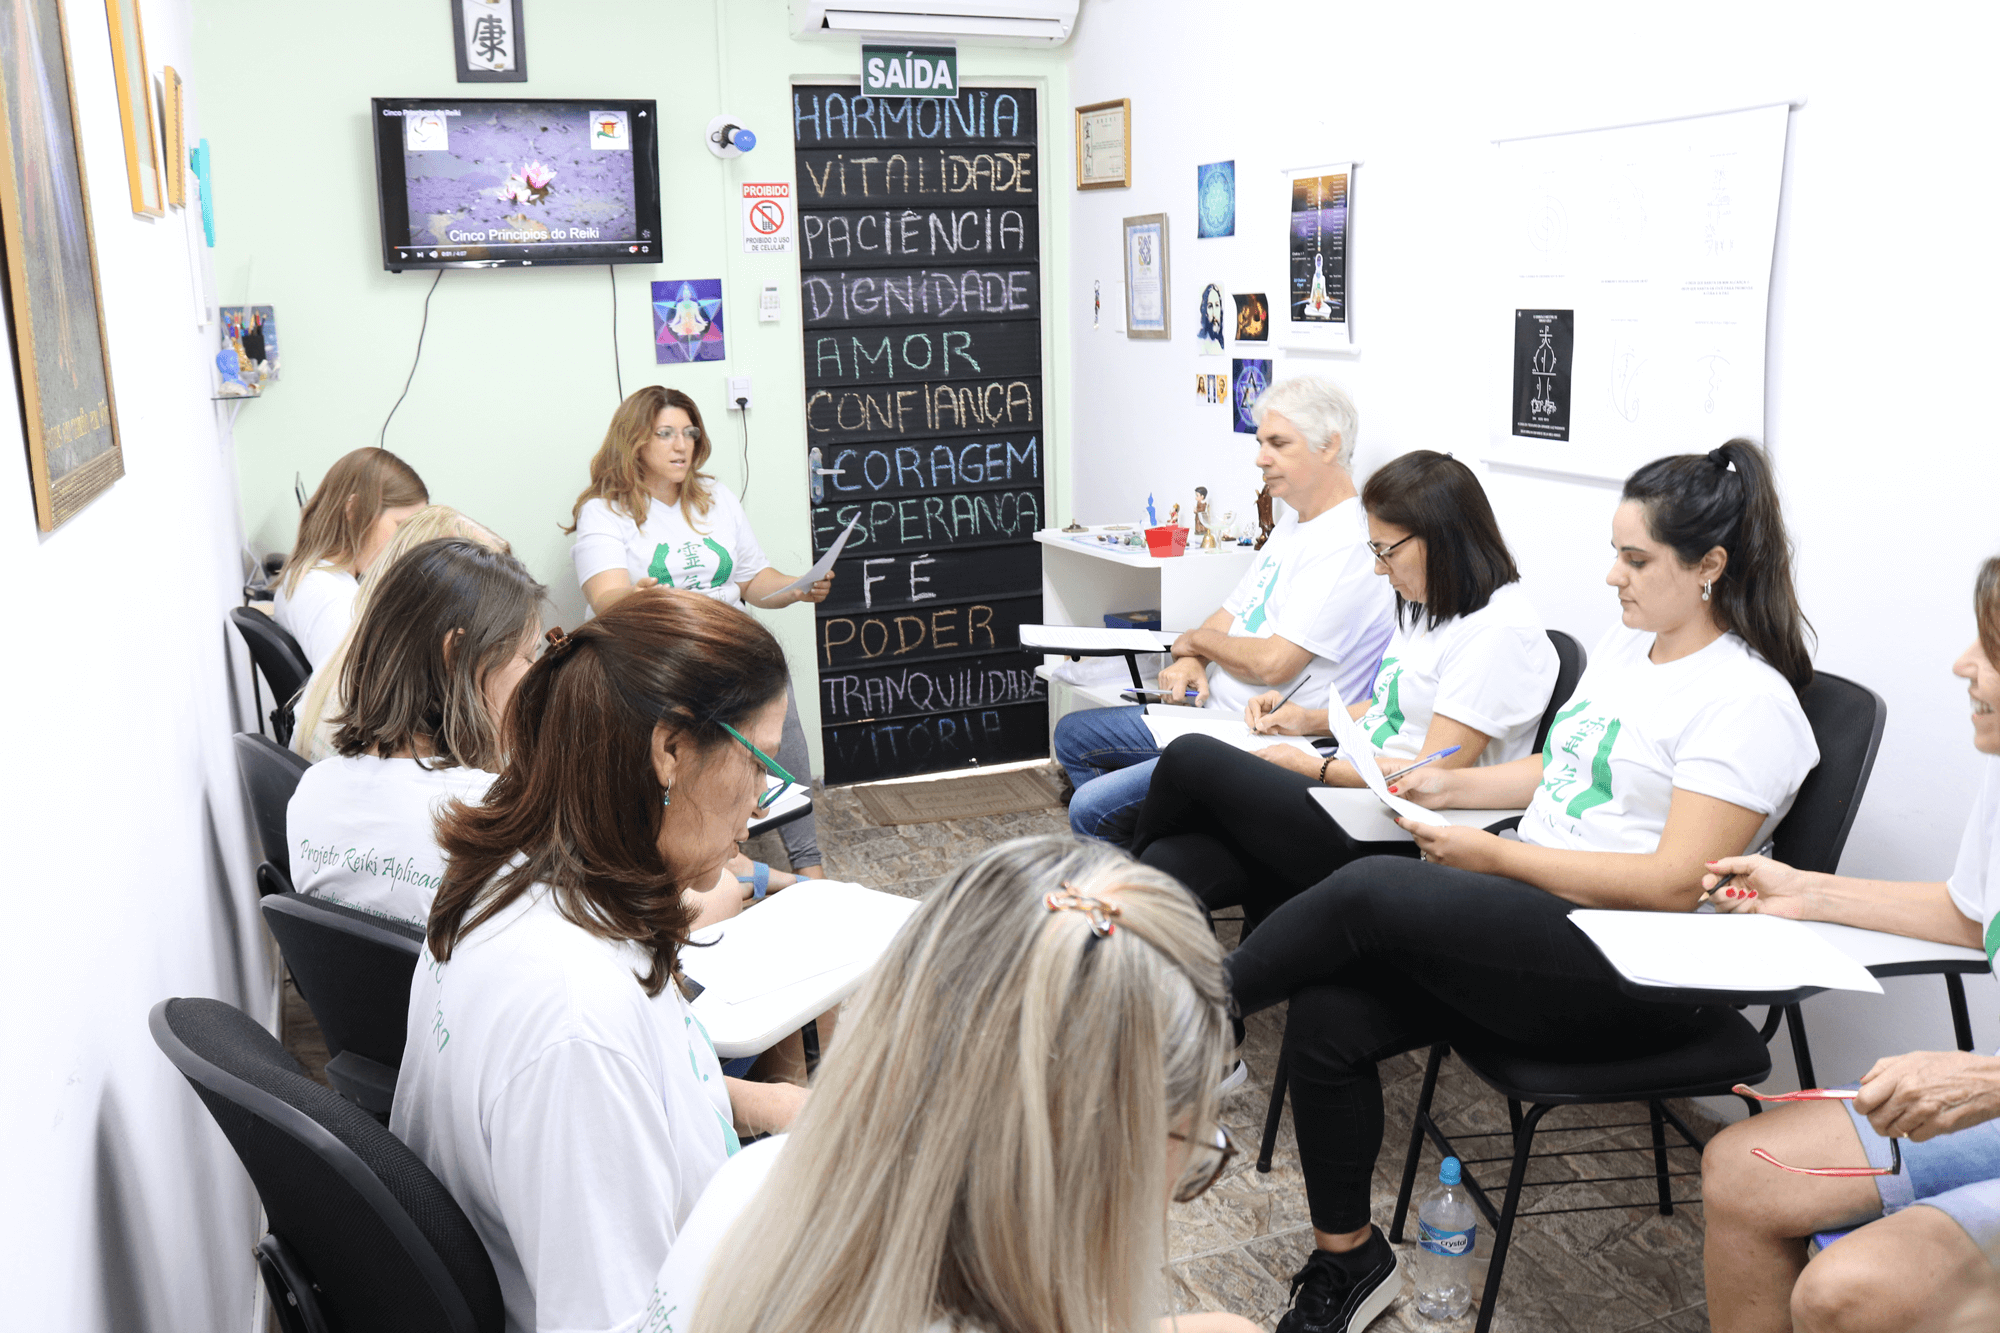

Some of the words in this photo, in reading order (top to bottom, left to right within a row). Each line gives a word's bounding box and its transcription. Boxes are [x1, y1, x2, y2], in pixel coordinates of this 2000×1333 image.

[867, 51, 954, 90] SAÍDA
[794, 91, 1019, 140] HARMONIA
[743, 185, 788, 197] PROIBIDO
[805, 150, 1033, 197] VITALIDADE
[449, 229, 486, 242] Cinco
[488, 228, 548, 242] Principios
[551, 227, 567, 240] do
[569, 226, 600, 240] Reiki
[804, 208, 1025, 259] PACIÊNCIA
[802, 270, 1032, 321] DIGNIDADE
[816, 330, 981, 379] AMOR
[807, 381, 1034, 433] CONFIANÇA
[832, 436, 1038, 491] CORAGEM
[811, 492, 1039, 551] ESPERANÇA
[864, 553, 936, 608] FÉ
[823, 605, 995, 666] PODER
[822, 668, 1045, 718] TRANQUILIDADE
[300, 839, 340, 875] Projeto
[341, 847, 379, 876] Reiki
